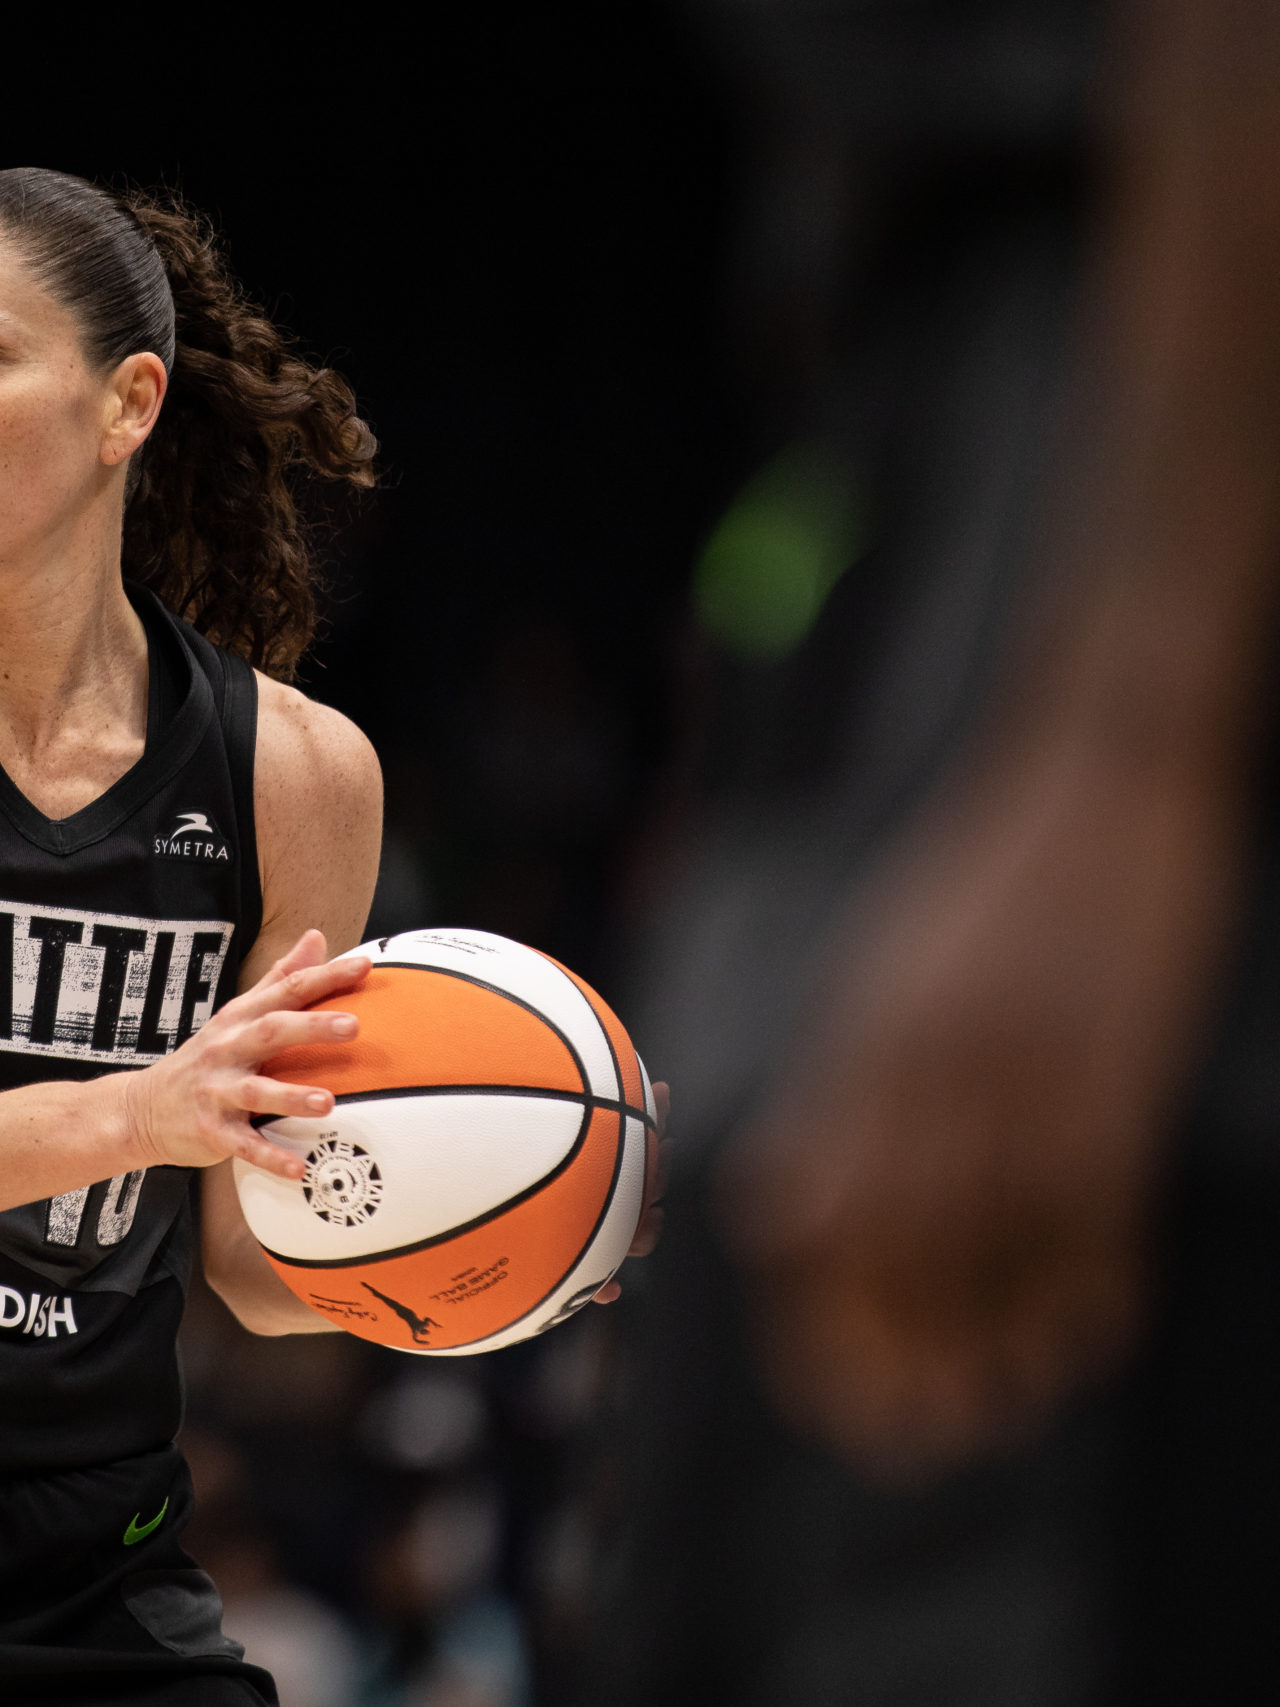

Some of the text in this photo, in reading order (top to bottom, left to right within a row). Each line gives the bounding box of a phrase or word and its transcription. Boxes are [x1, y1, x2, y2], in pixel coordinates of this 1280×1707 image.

[153, 838, 229, 861] SYMETRA
[428, 1256, 510, 1300] GAME BALL
